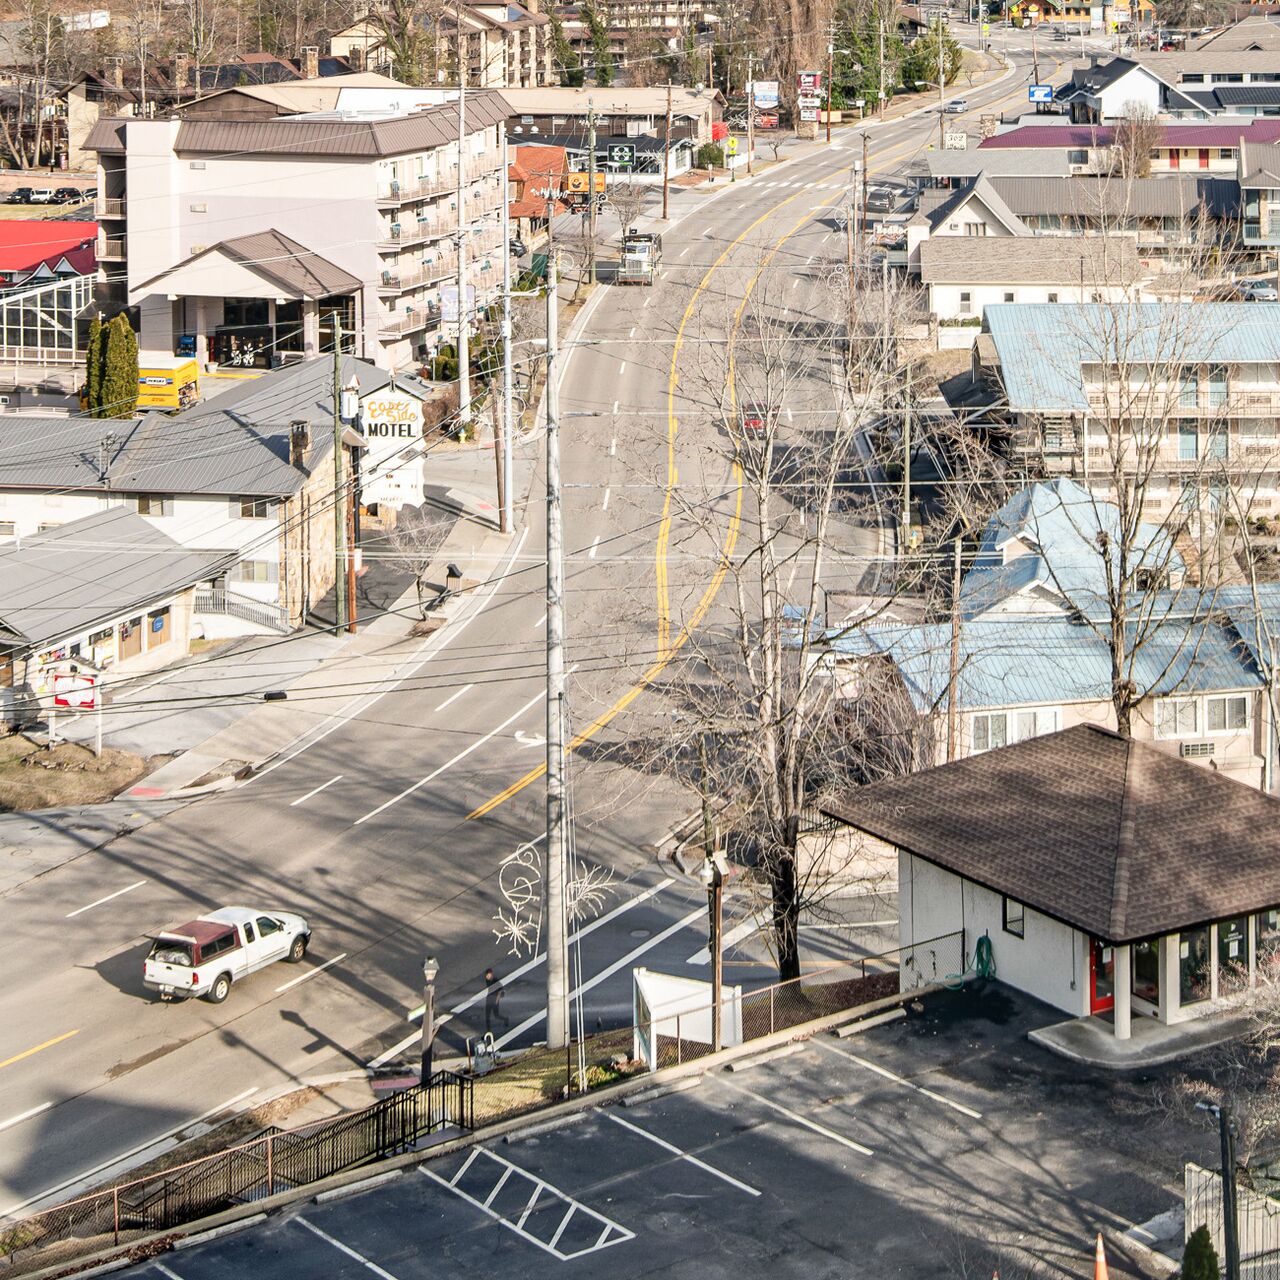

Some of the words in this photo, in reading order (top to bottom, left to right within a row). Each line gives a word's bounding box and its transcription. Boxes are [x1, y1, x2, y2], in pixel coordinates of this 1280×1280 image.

[368, 401, 411, 419] East
[386, 408, 418, 422] Side
[368, 423, 417, 437] MOTEL
